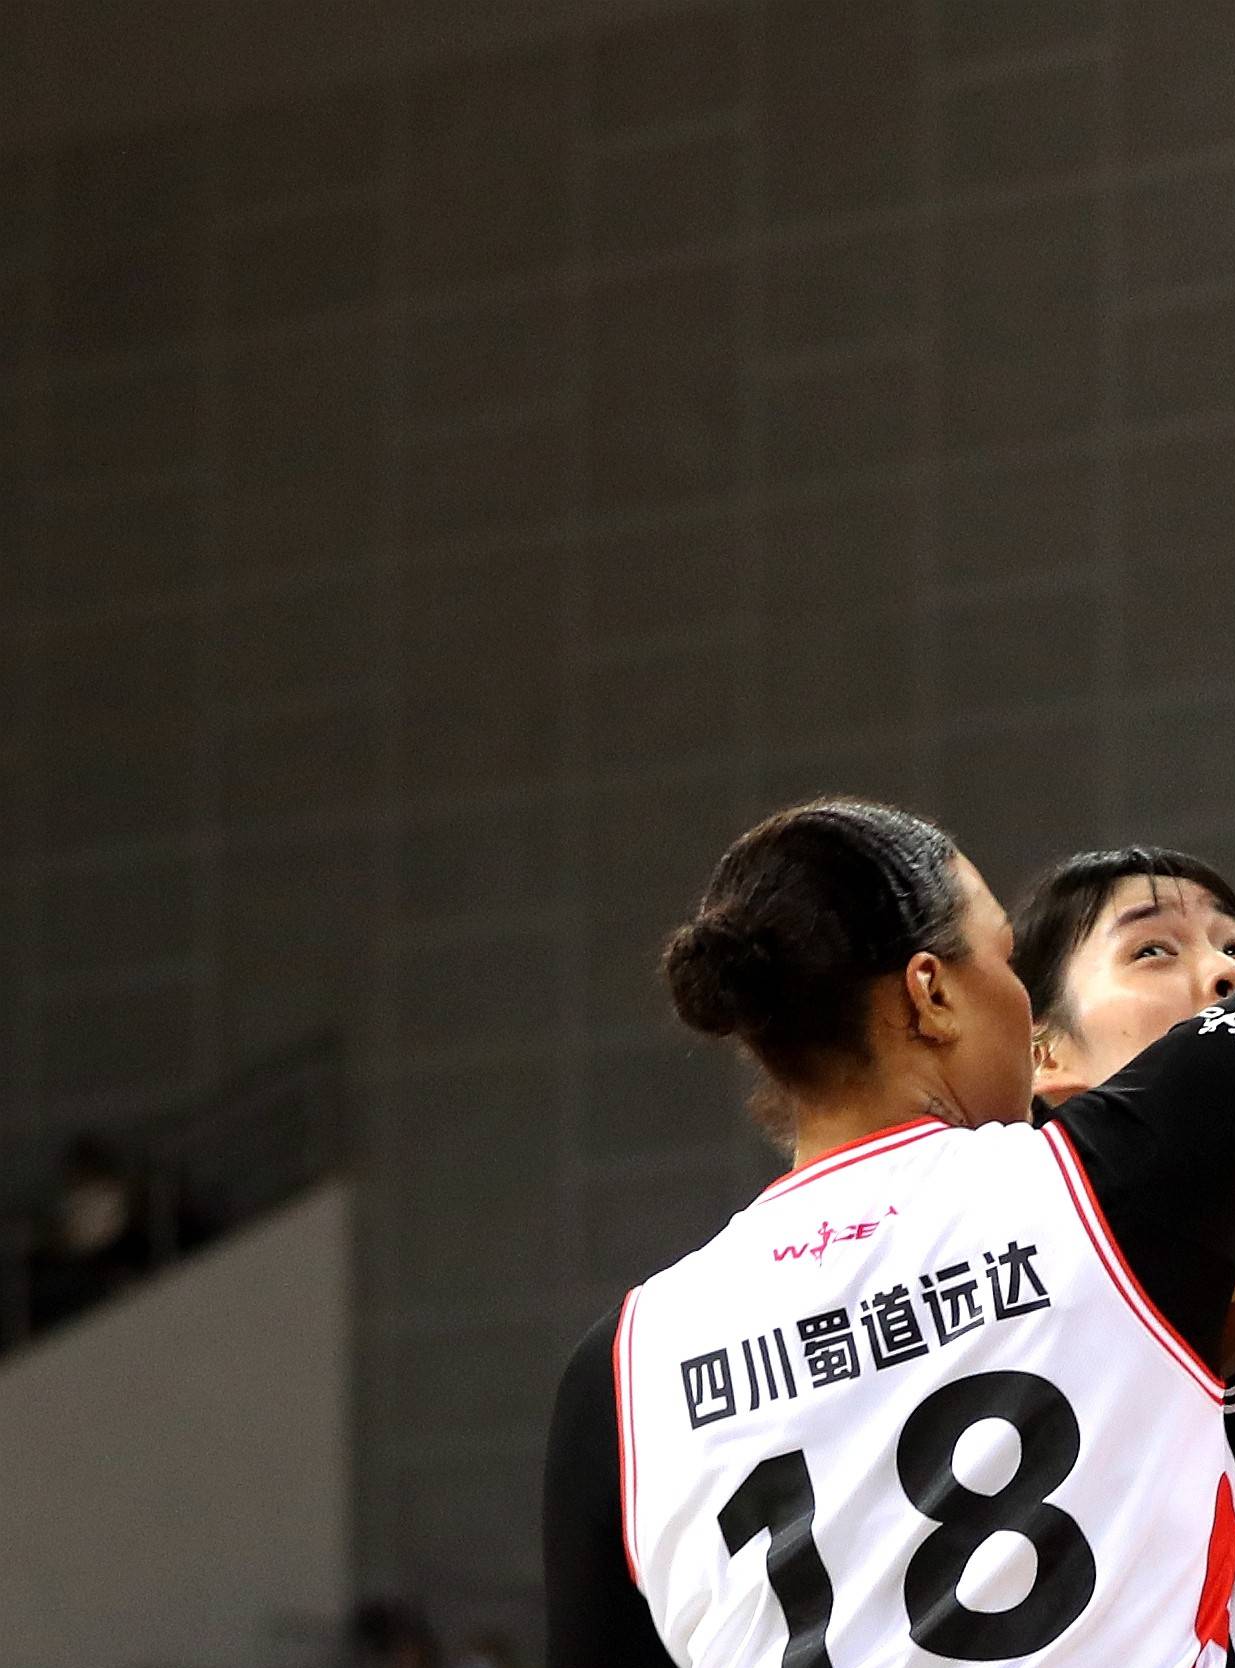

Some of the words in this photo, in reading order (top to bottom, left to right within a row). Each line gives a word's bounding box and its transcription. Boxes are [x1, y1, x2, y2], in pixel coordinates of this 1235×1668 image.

[680, 1240, 1052, 1430] 四川蜀道远达
